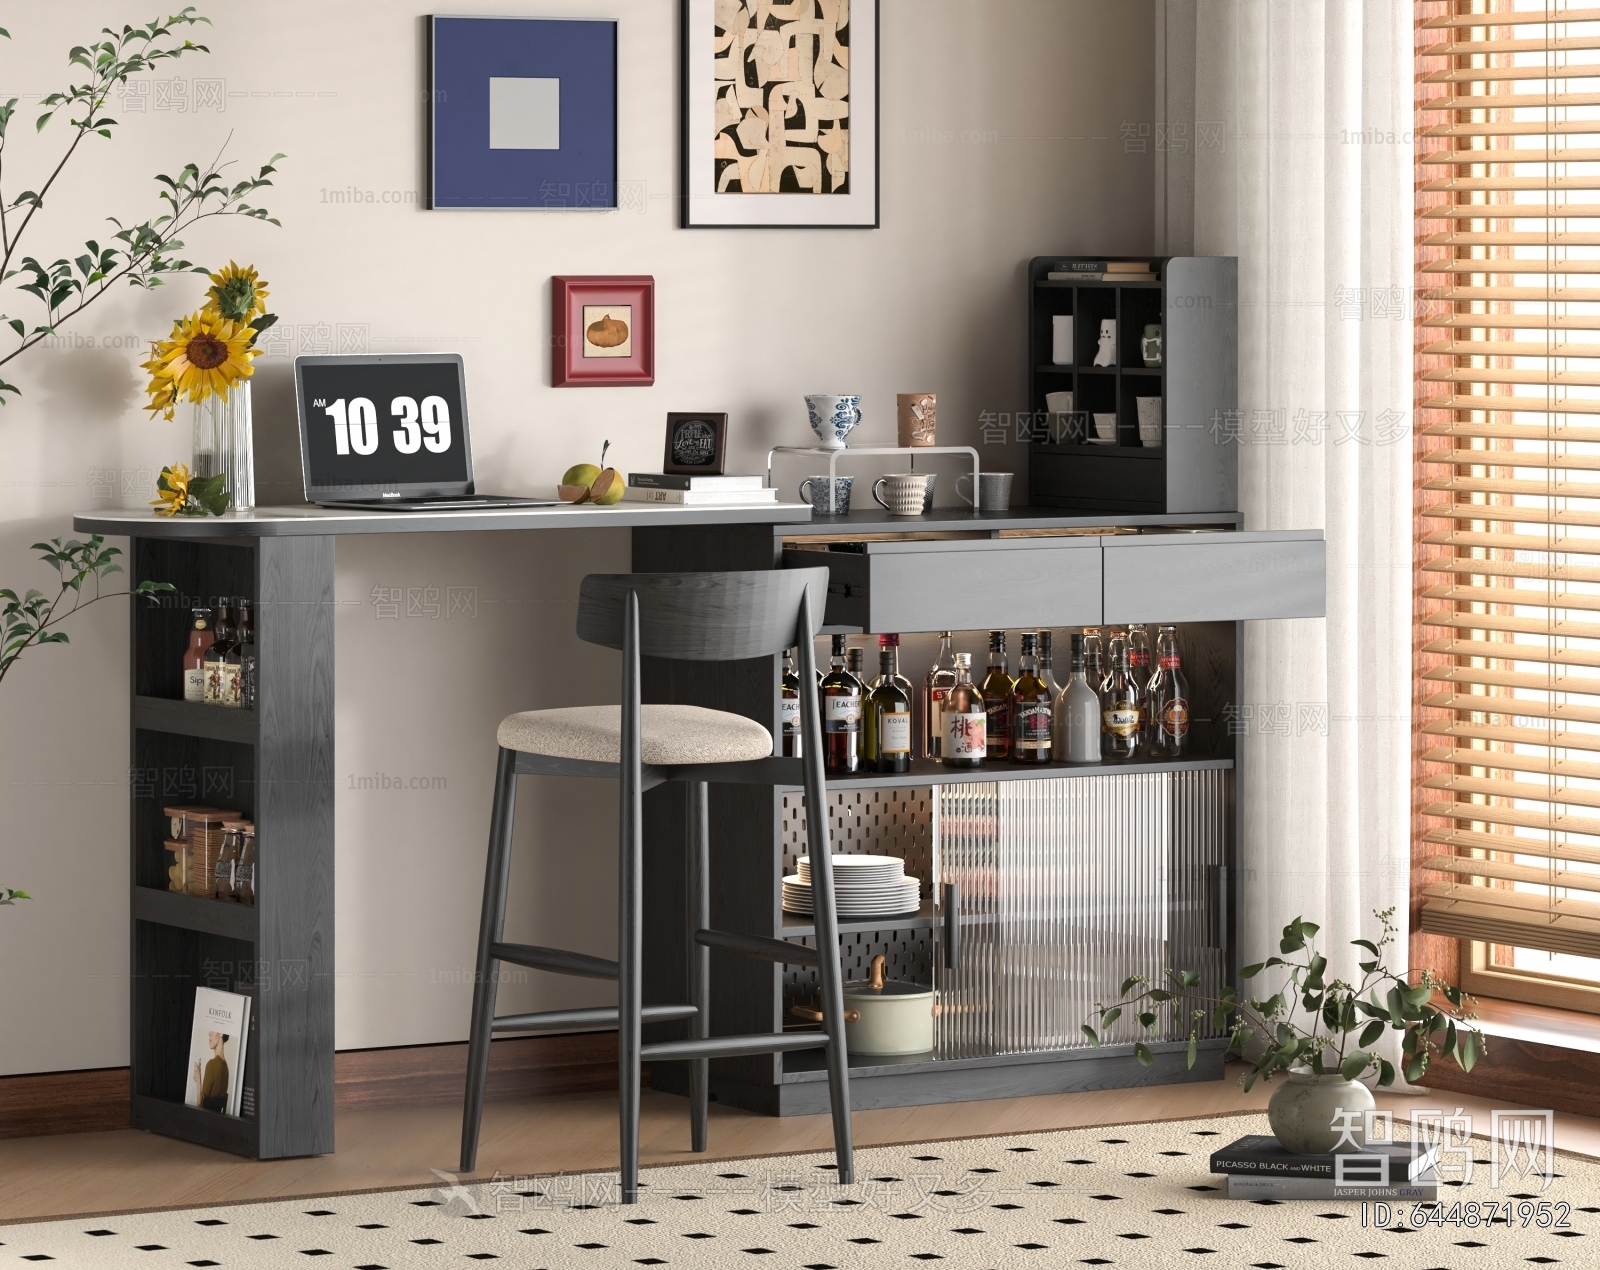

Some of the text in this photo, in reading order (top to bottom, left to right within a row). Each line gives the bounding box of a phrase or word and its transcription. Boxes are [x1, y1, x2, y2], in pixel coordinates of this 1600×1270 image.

[313, 395, 452, 456] AM 10 39
[655, 491, 667, 501] ART
[951, 715, 973, 738] 桃
[208, 1007, 232, 1020] KINFOLK
[1216, 1160, 1257, 1169] PICASSO
[1259, 1162, 1289, 1171] BLACK
[1301, 1164, 1332, 1173] WHITE
[1333, 1188, 1424, 1197] JASPER JOHNS GRAY
